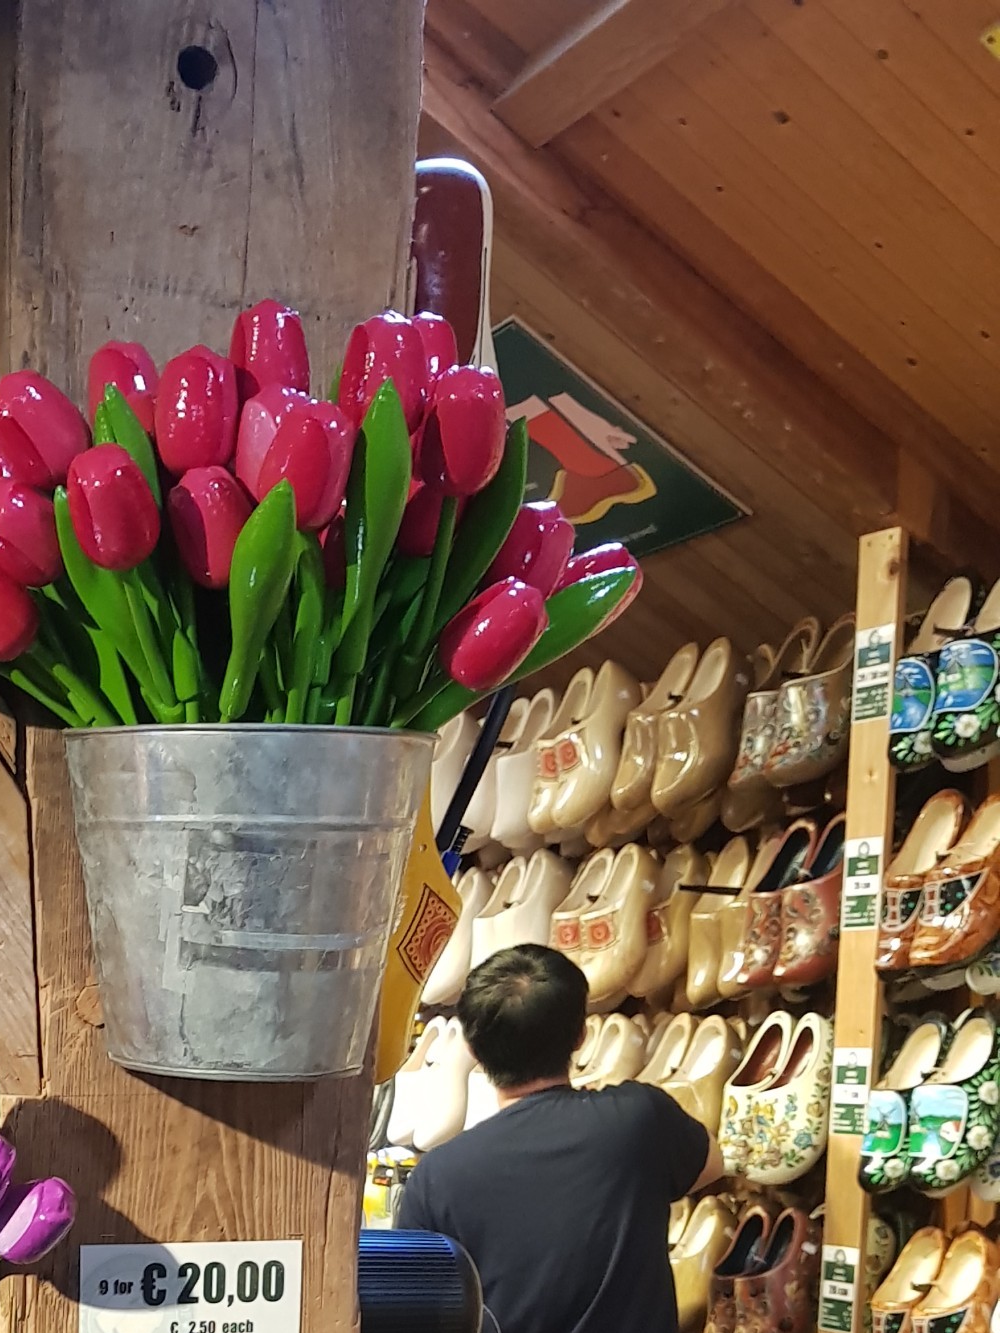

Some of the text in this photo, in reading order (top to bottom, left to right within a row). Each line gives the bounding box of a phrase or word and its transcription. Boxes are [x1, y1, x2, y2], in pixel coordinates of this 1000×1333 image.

[99, 1260, 285, 1307] 9 for € 20,00
